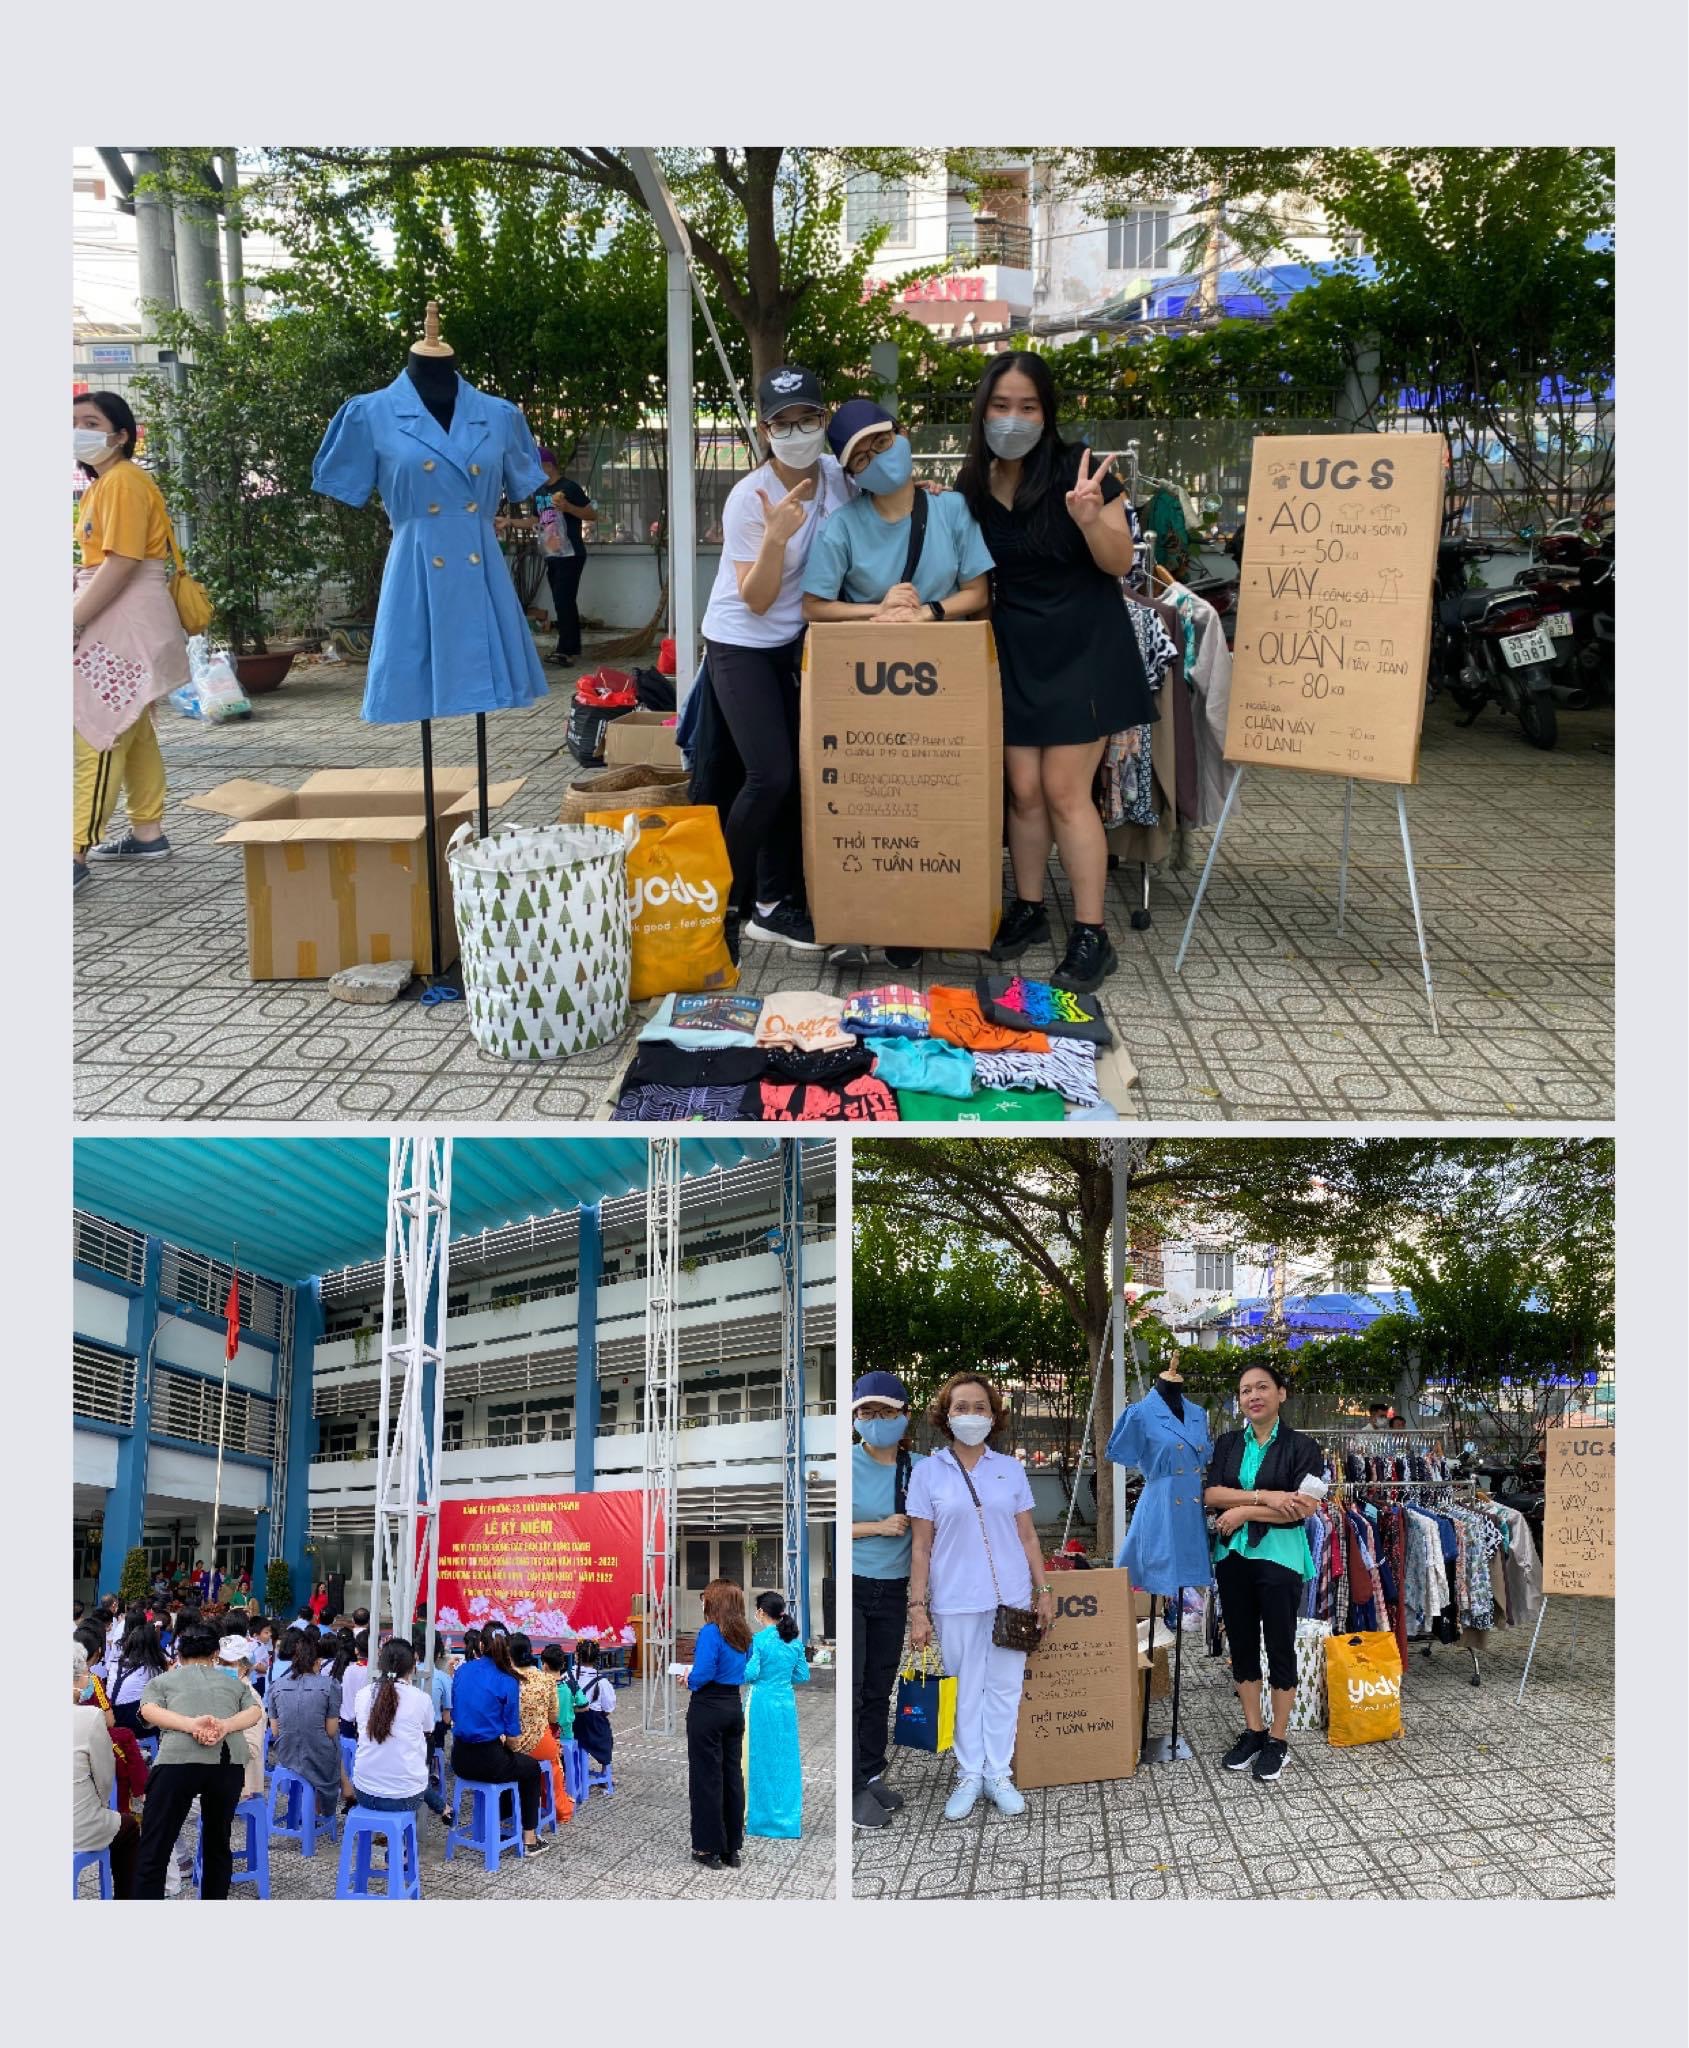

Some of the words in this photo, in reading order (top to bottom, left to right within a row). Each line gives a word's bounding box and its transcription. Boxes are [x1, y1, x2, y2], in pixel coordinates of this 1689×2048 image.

[1300, 458, 1395, 490] UCS
[1269, 495, 1322, 535] ÁO
[1314, 538, 1344, 563] 50
[1266, 561, 1319, 601] VÁY
[1307, 605, 1337, 630] 150
[1259, 629, 1345, 670] QUẦN
[855, 661, 939, 696] UCS
[1301, 672, 1330, 699] 80
[871, 836, 920, 849] TRANG
[872, 851, 913, 873] TUẦN
[920, 852, 961, 874] HOÀN
